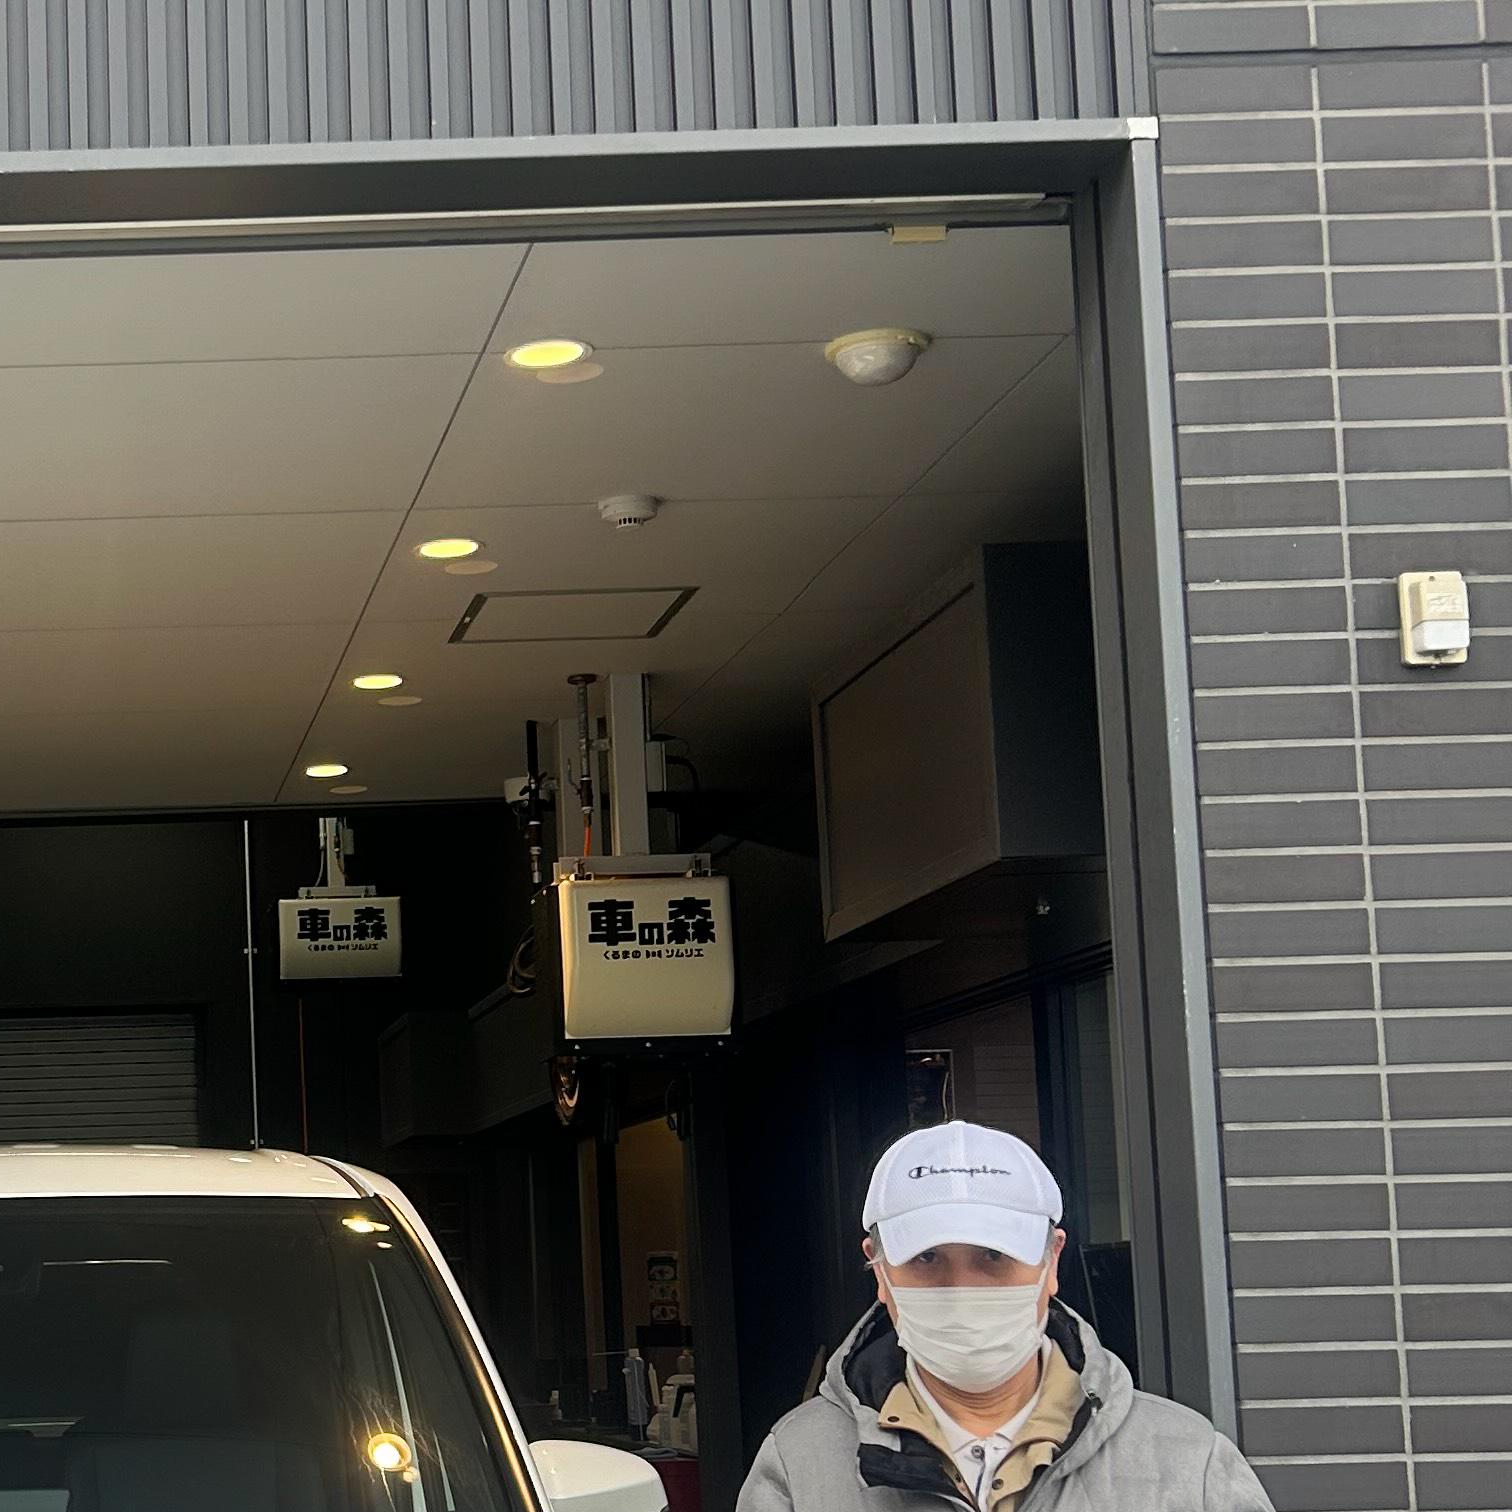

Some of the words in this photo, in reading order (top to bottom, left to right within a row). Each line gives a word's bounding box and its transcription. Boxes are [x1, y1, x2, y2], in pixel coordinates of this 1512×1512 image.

[297, 906, 388, 942] 車の森
[587, 896, 716, 946] 車の森
[908, 1164, 1011, 1180] Champion
